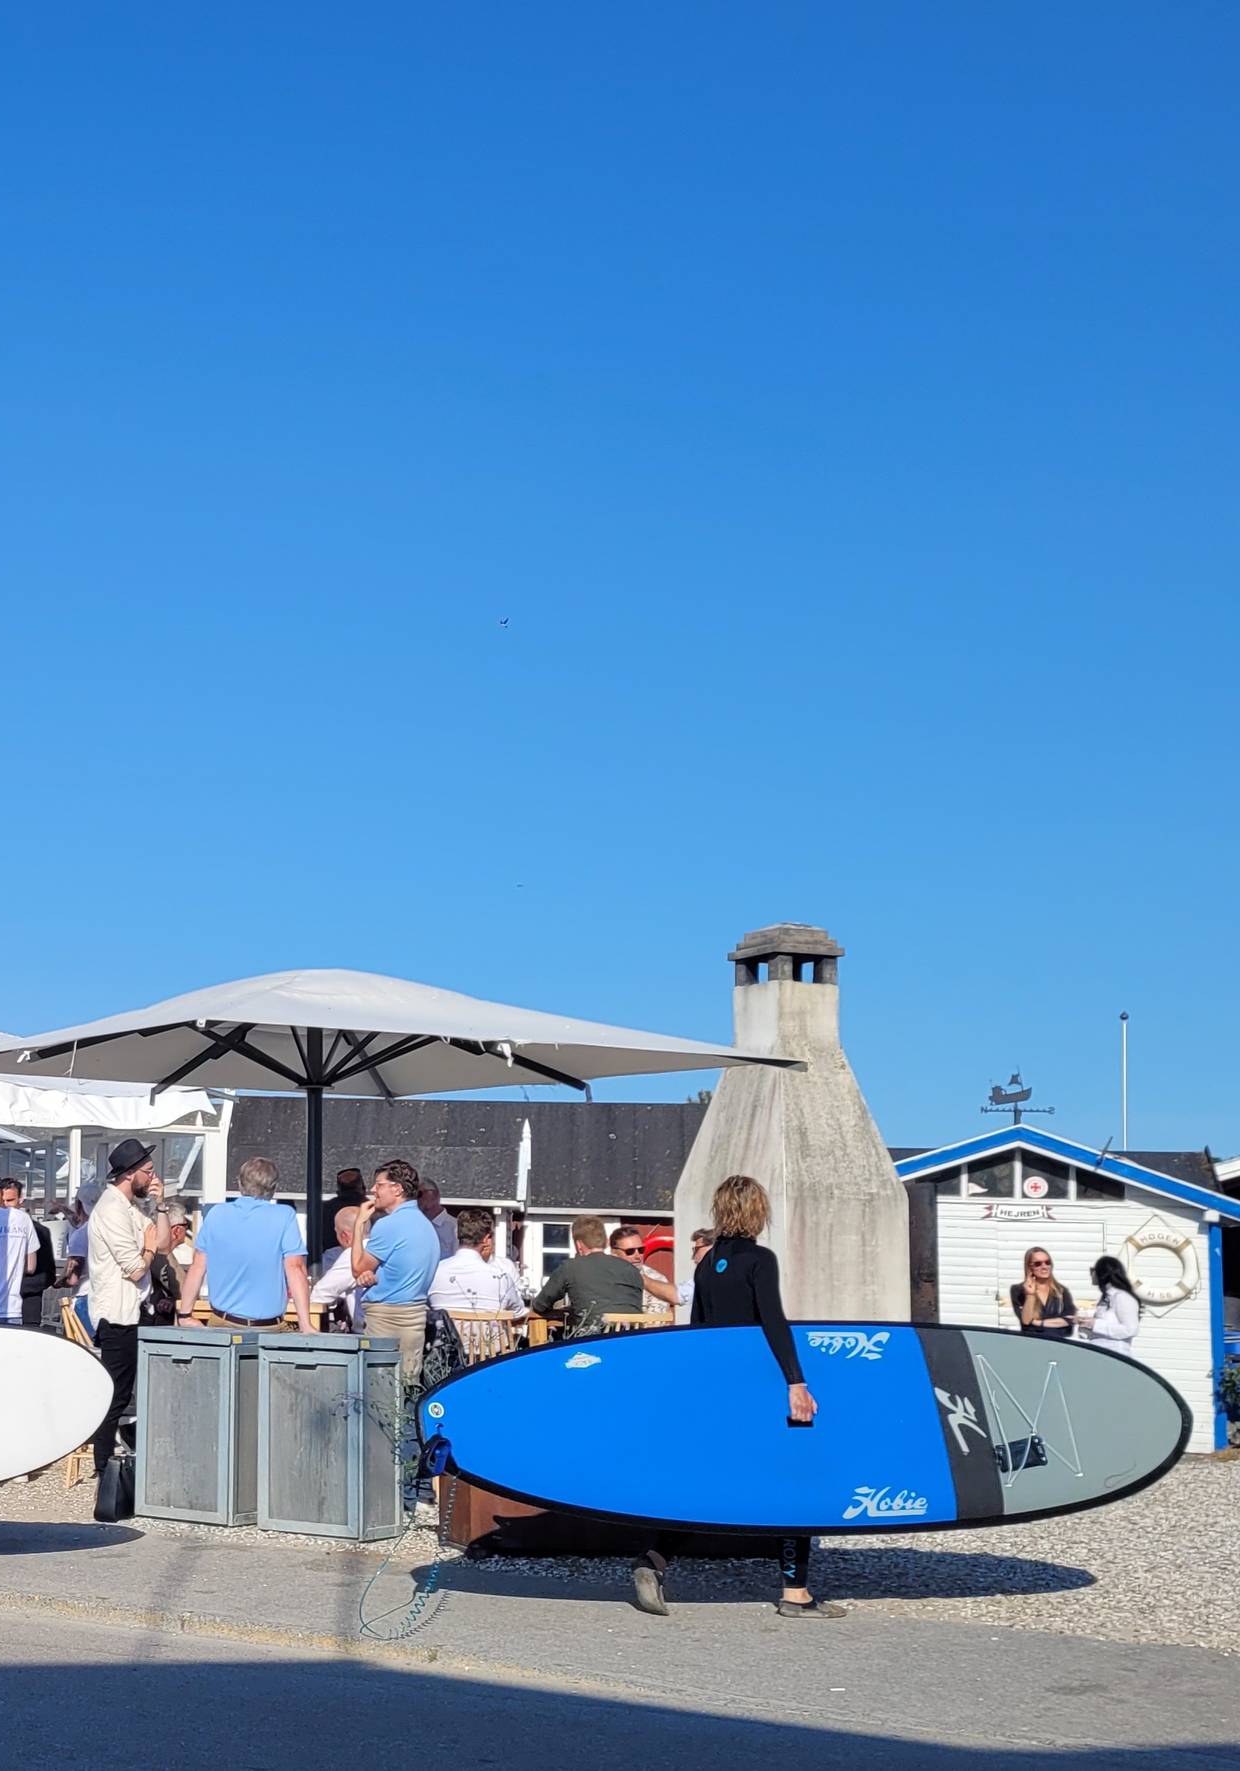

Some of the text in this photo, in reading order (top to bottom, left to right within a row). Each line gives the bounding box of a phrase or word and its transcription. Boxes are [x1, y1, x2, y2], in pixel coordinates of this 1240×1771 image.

[1000, 1208, 1040, 1218] HEJREN
[806, 1331, 890, 1360] Hobie
[842, 1486, 928, 1519] Hobie
[783, 1539, 797, 1579] ROXY
